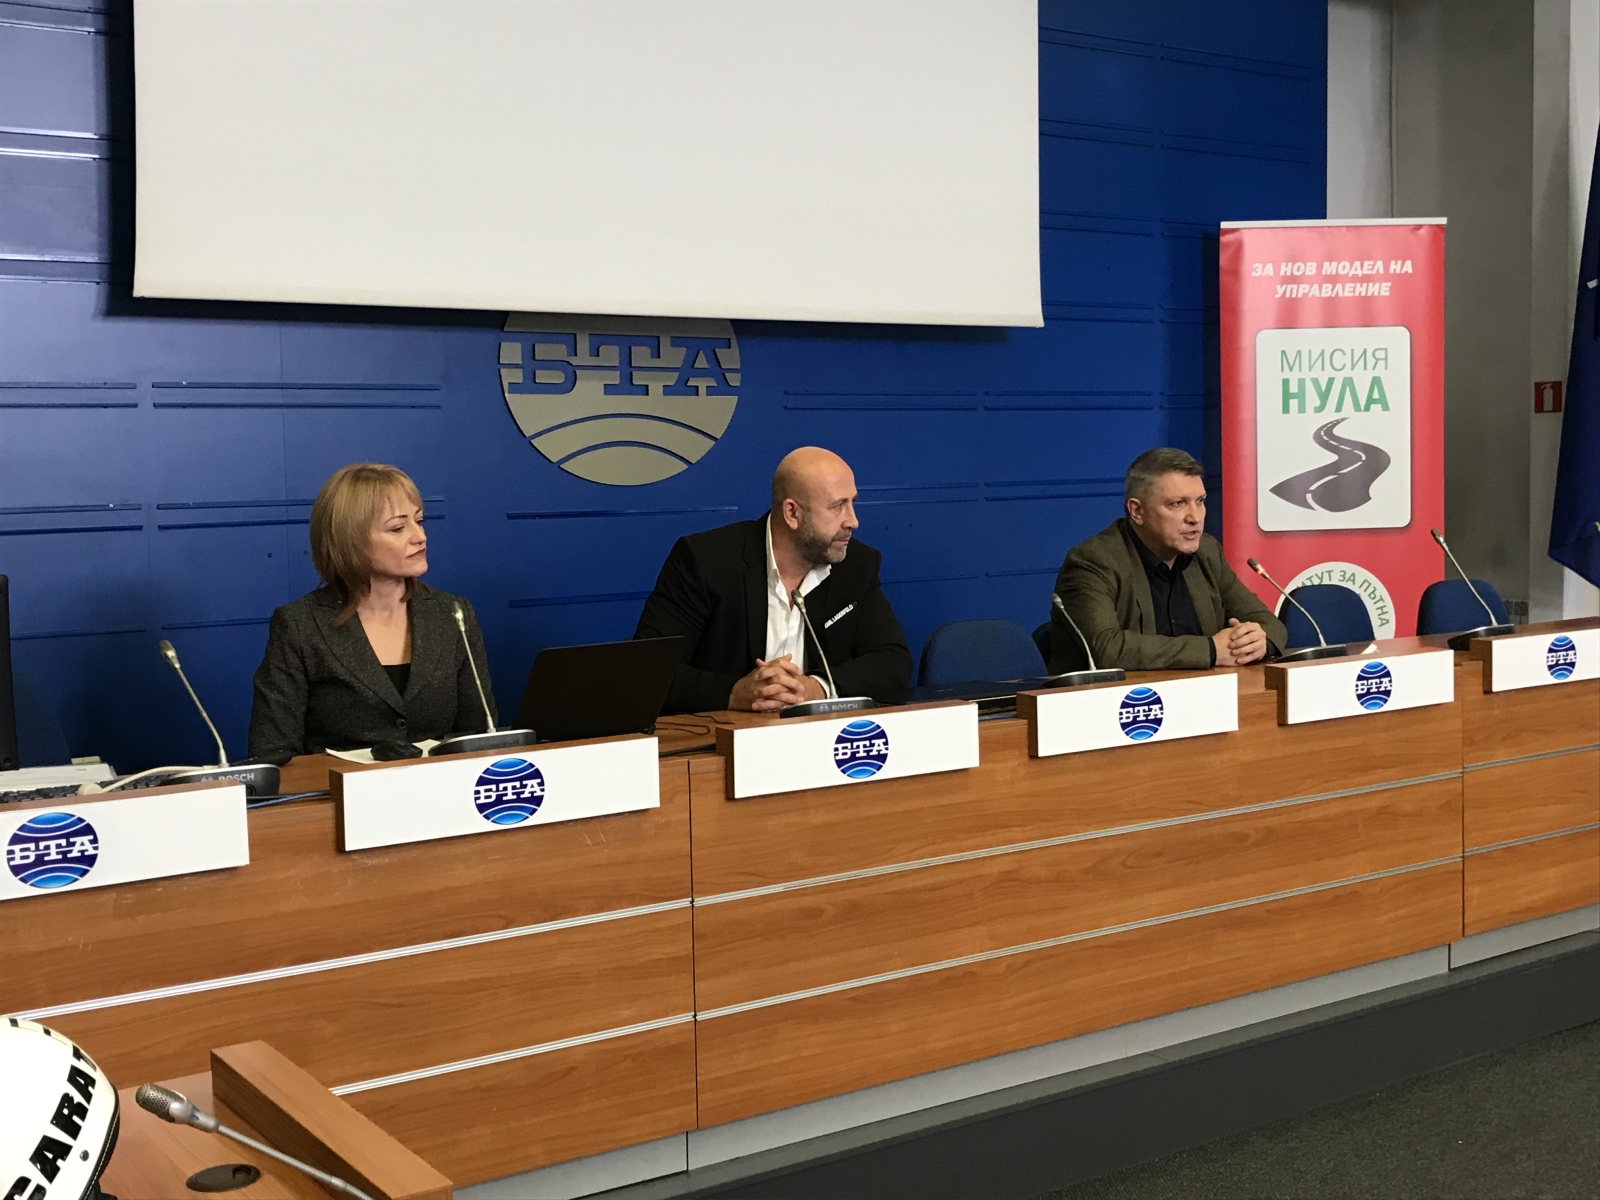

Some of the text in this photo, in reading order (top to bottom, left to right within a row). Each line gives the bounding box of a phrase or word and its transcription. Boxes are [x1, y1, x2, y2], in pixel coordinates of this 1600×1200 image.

[1251, 259, 1414, 278] ЗА НОВ МОДЕЛ НА
[1274, 282, 1392, 299] УПРАВЛЕНИЕ
[499, 331, 740, 397] БТА
[1280, 347, 1389, 373] МИСИЯ
[1281, 375, 1391, 415] НУЛА
[1297, 569, 1390, 628] ТУТ ЗА ПЪТНА
[1546, 650, 1577, 665] БТА
[1355, 676, 1393, 694] БТА
[1119, 704, 1164, 723] БТА
[834, 738, 889, 760] БТА
[474, 778, 545, 804] БТА
[6, 835, 99, 866] БТА
